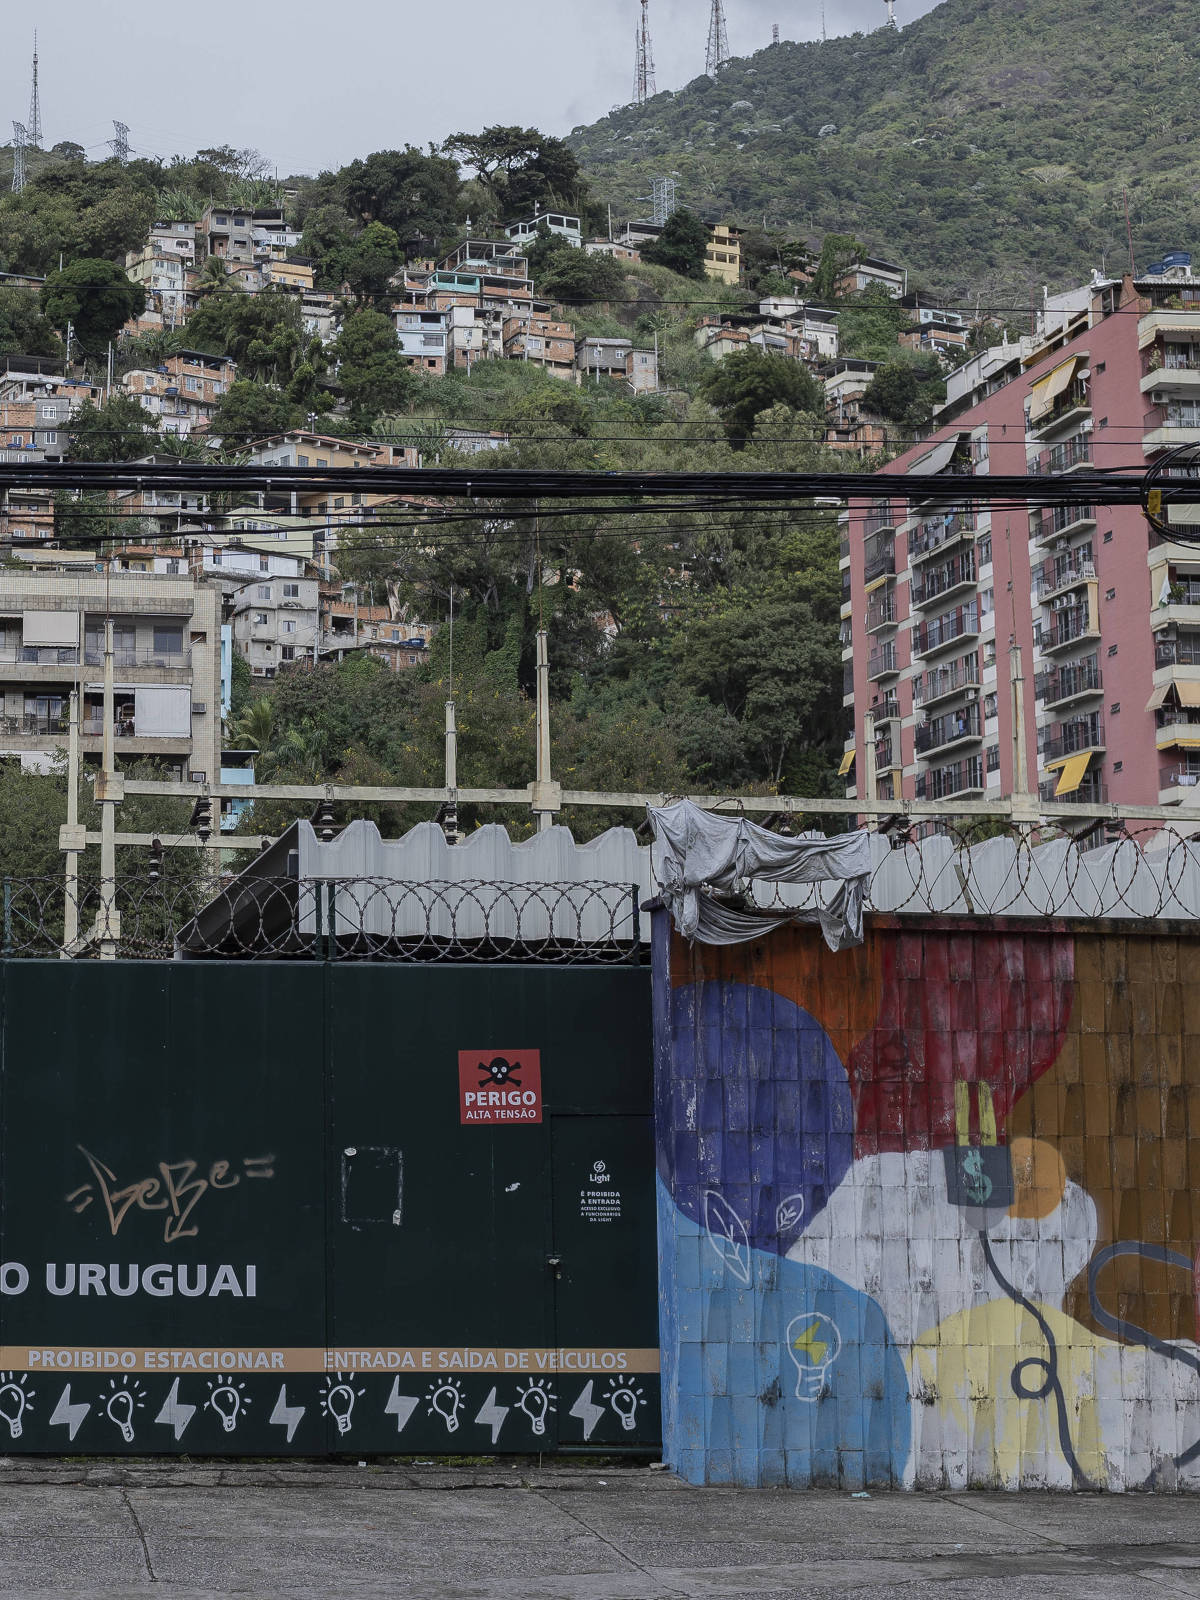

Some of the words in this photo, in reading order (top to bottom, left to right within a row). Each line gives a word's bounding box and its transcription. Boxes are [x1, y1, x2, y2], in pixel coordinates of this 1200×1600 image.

[465, 1090, 536, 1106] PERIGO
[466, 1110, 491, 1119] ALTA
[494, 1108, 536, 1119] TENSÃO
[590, 1174, 610, 1183] Light
[46, 1263, 256, 1297] URUGUAI
[28, 1350, 137, 1368] PROIBIDO
[144, 1351, 285, 1368] ESTACIONAR
[323, 1351, 415, 1369] ENTRADA
[421, 1351, 432, 1369] E
[438, 1348, 498, 1369] SAÍDA
[504, 1351, 529, 1369] DE
[535, 1348, 627, 1369] VEÍCULOS
